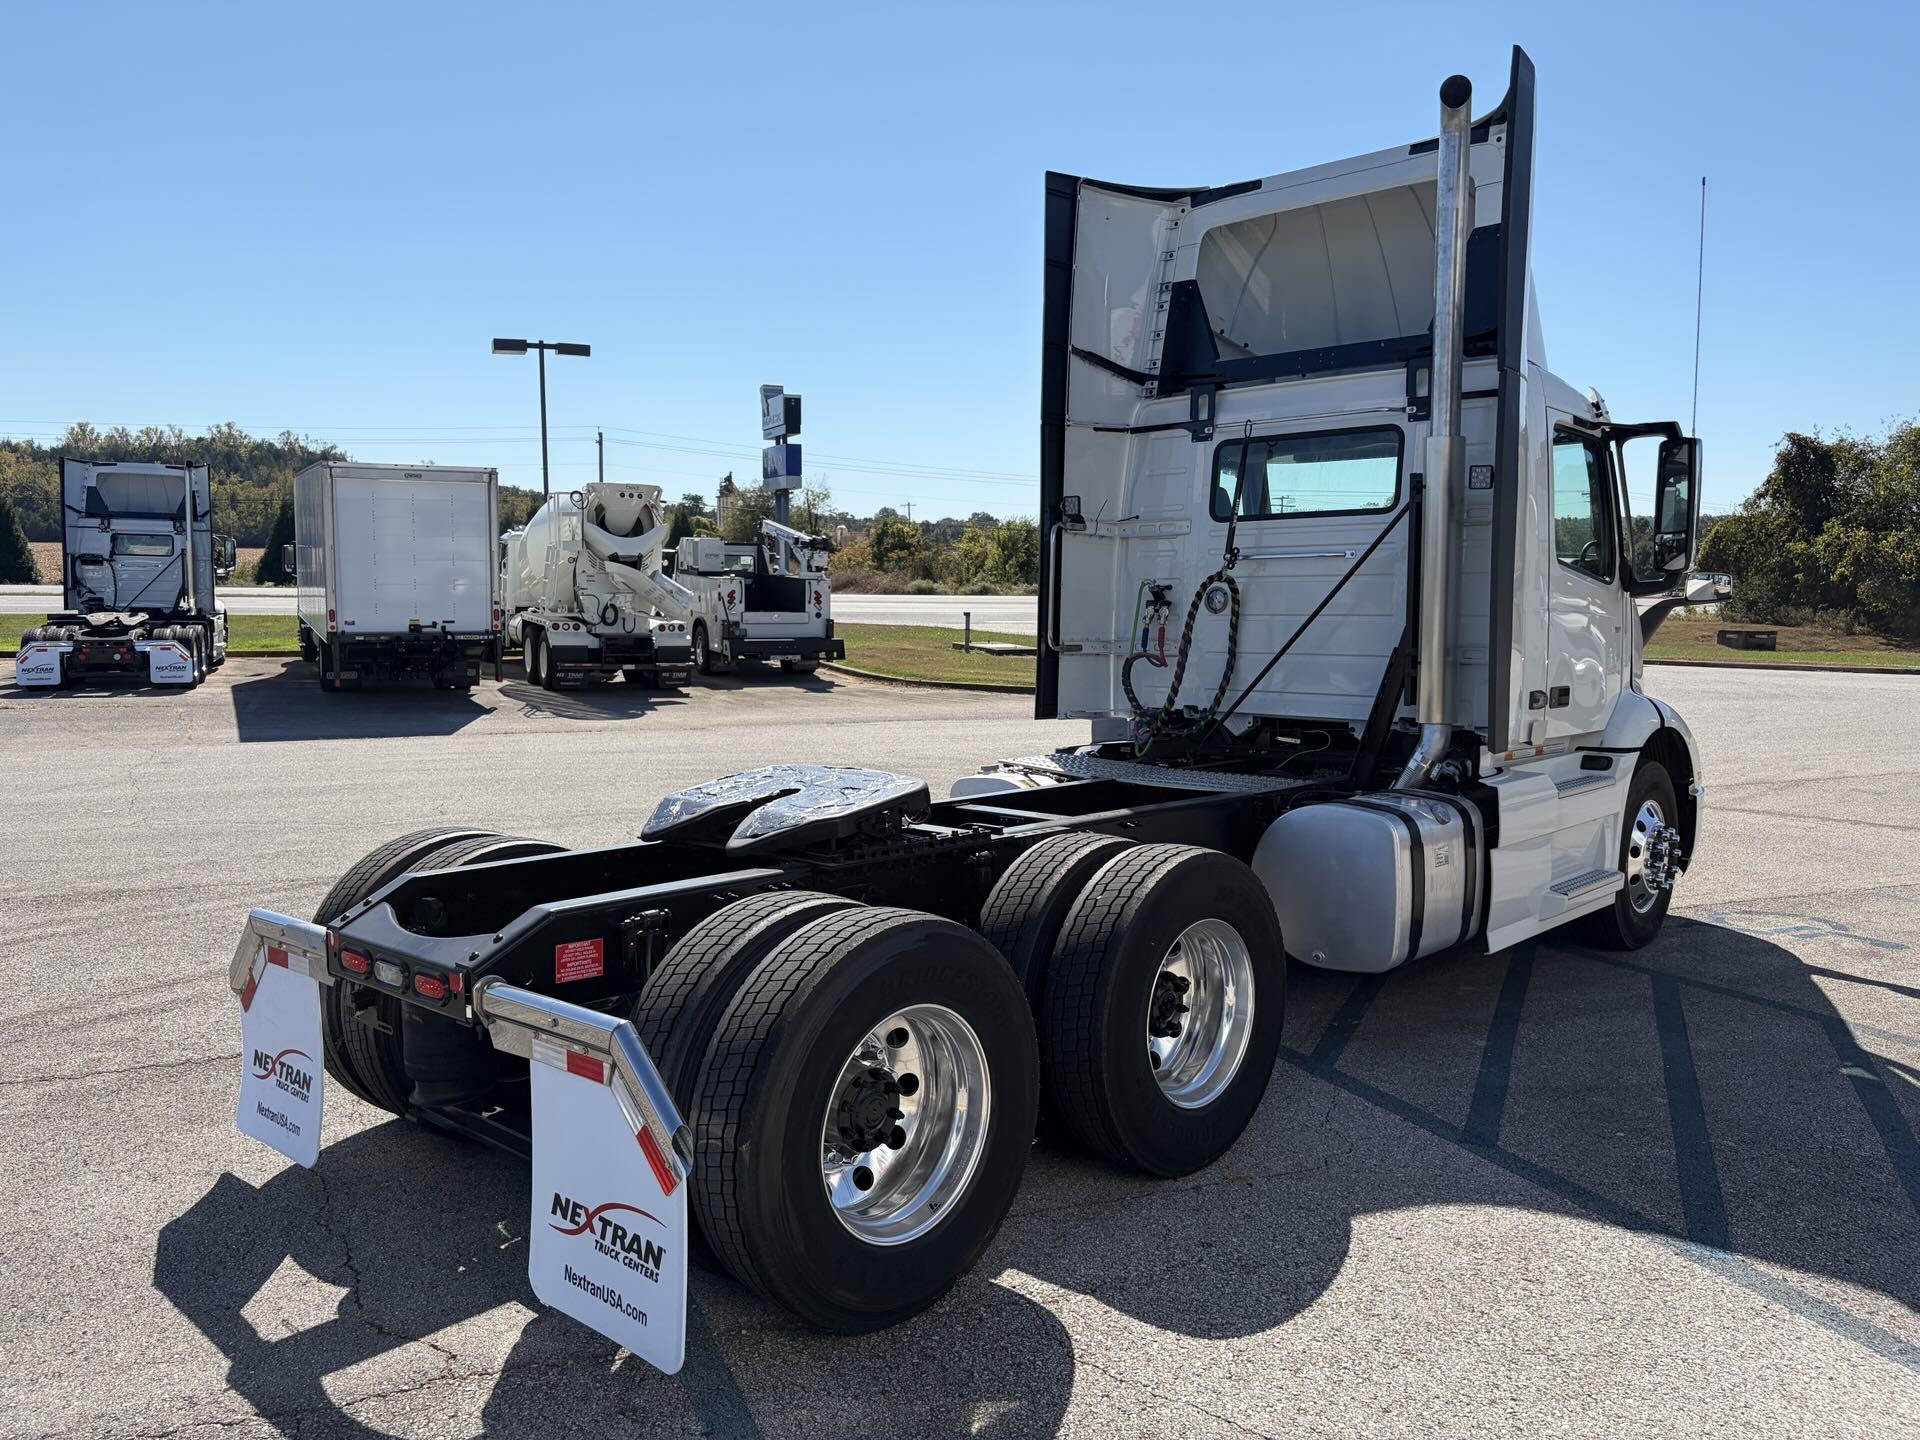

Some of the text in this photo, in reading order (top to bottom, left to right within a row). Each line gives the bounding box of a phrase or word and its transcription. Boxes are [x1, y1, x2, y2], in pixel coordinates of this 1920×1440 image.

[22, 666, 54, 674] NEXTRAN
[253, 1049, 312, 1093] NEXTRAN
[276, 1079, 310, 1104] TRUCK CENTERS
[256, 1101, 300, 1136] NextranUSA.com
[551, 1192, 664, 1270] NEXTRAN
[594, 1239, 660, 1284] TRUCK CENTERS
[564, 1264, 648, 1327] NextranUSA.com
